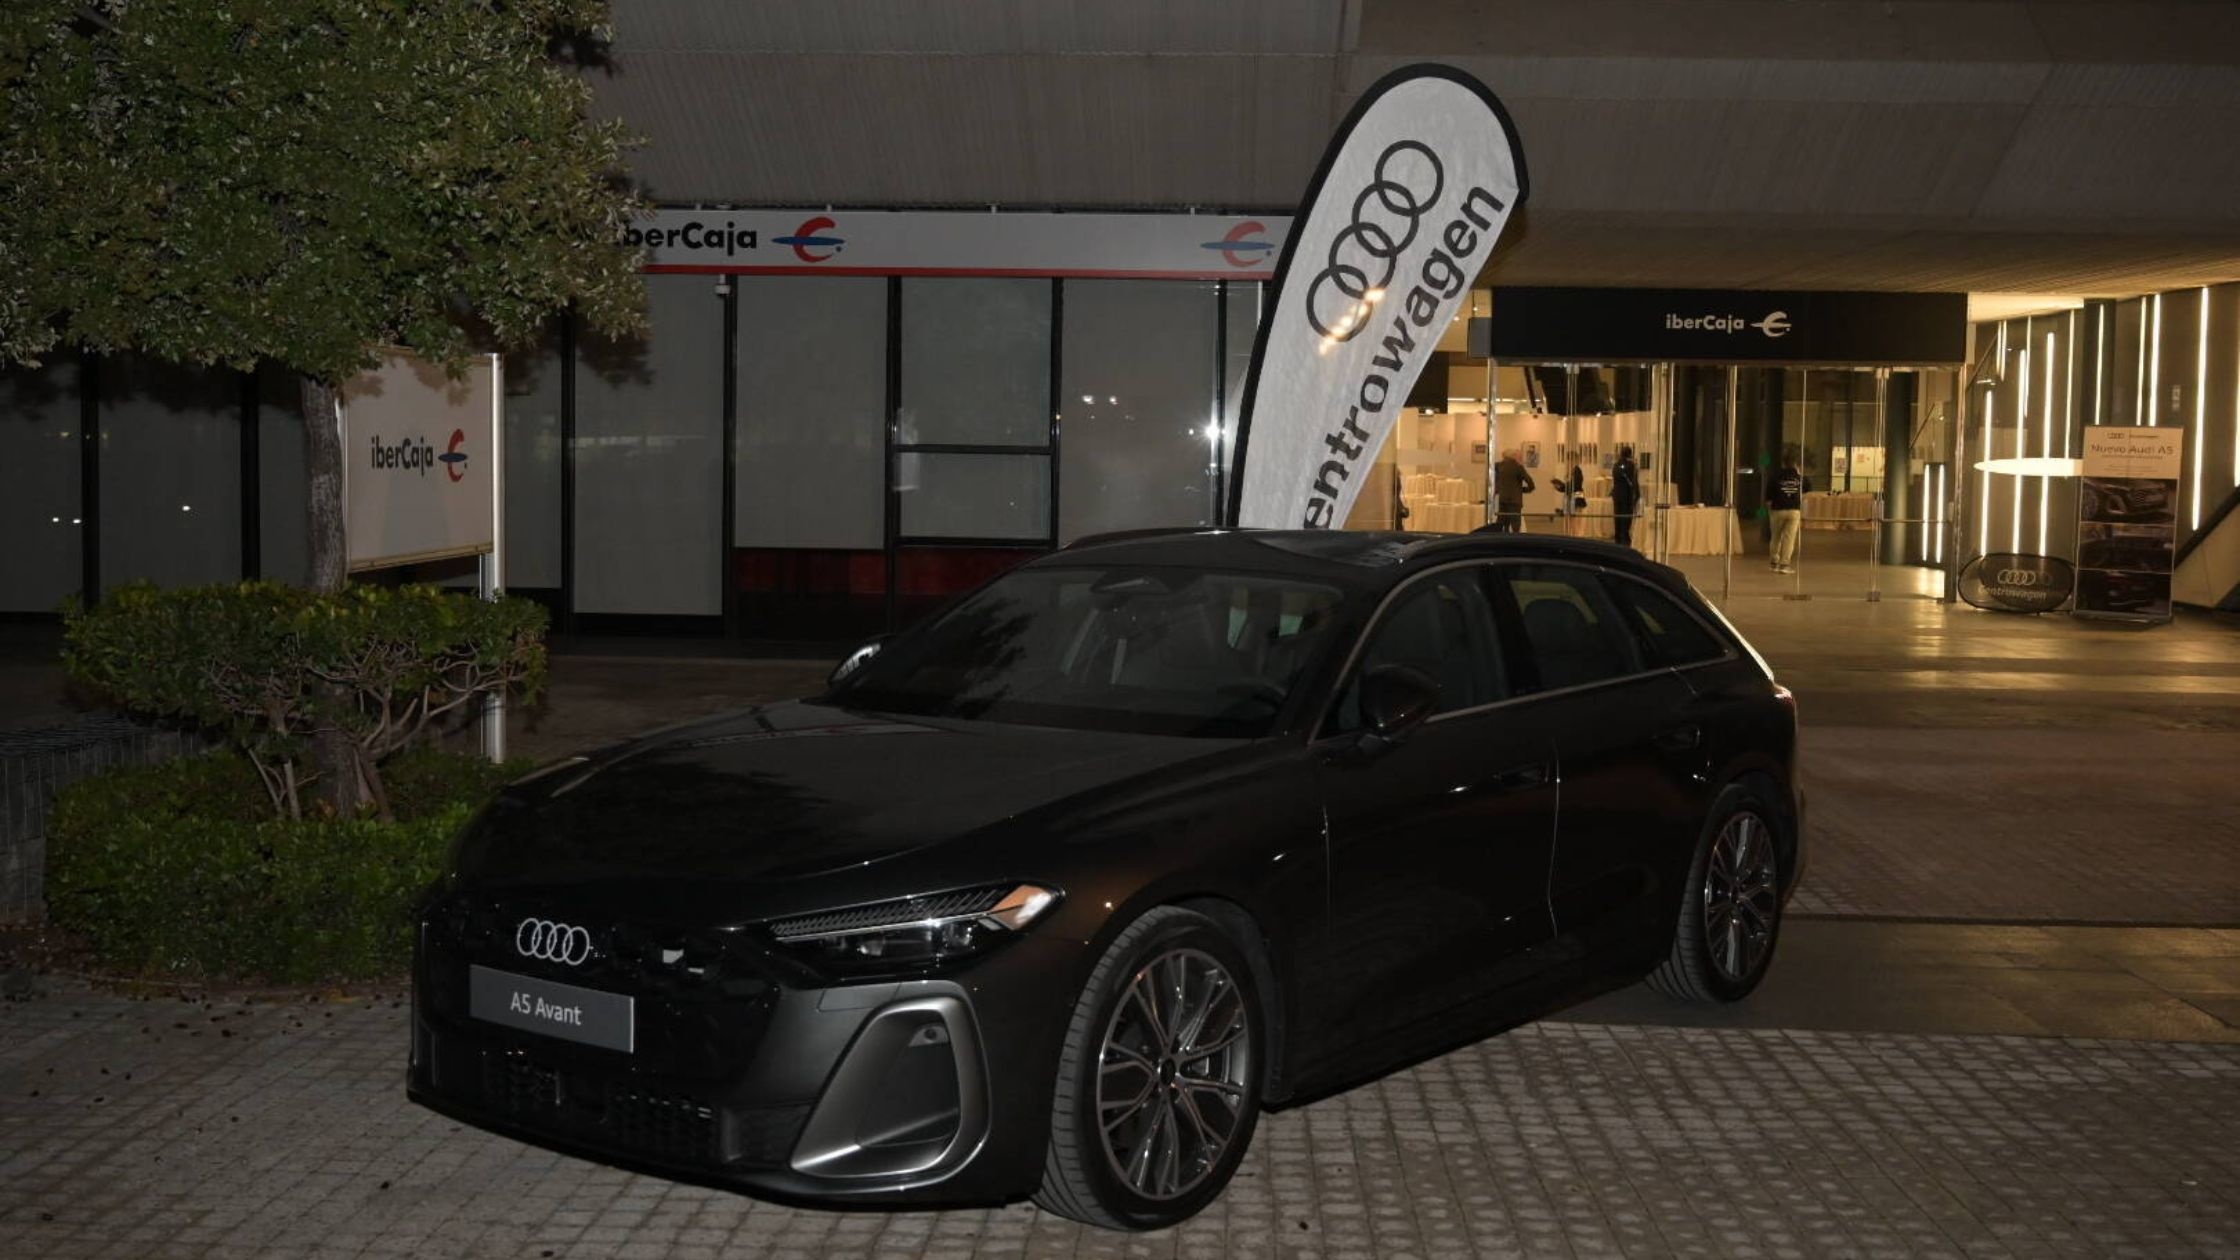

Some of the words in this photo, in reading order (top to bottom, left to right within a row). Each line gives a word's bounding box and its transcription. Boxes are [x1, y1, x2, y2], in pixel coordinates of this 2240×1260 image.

[617, 221, 758, 256] berCaja
[1665, 313, 1745, 334] iberCaja
[1303, 186, 1506, 529] entrowagen
[370, 434, 434, 477] iberCaja
[2091, 443, 2127, 454] Nuevo
[2128, 445, 2156, 455] Audi
[2157, 446, 2175, 455] A5
[510, 991, 532, 1014] A5
[534, 997, 583, 1026] Avant
